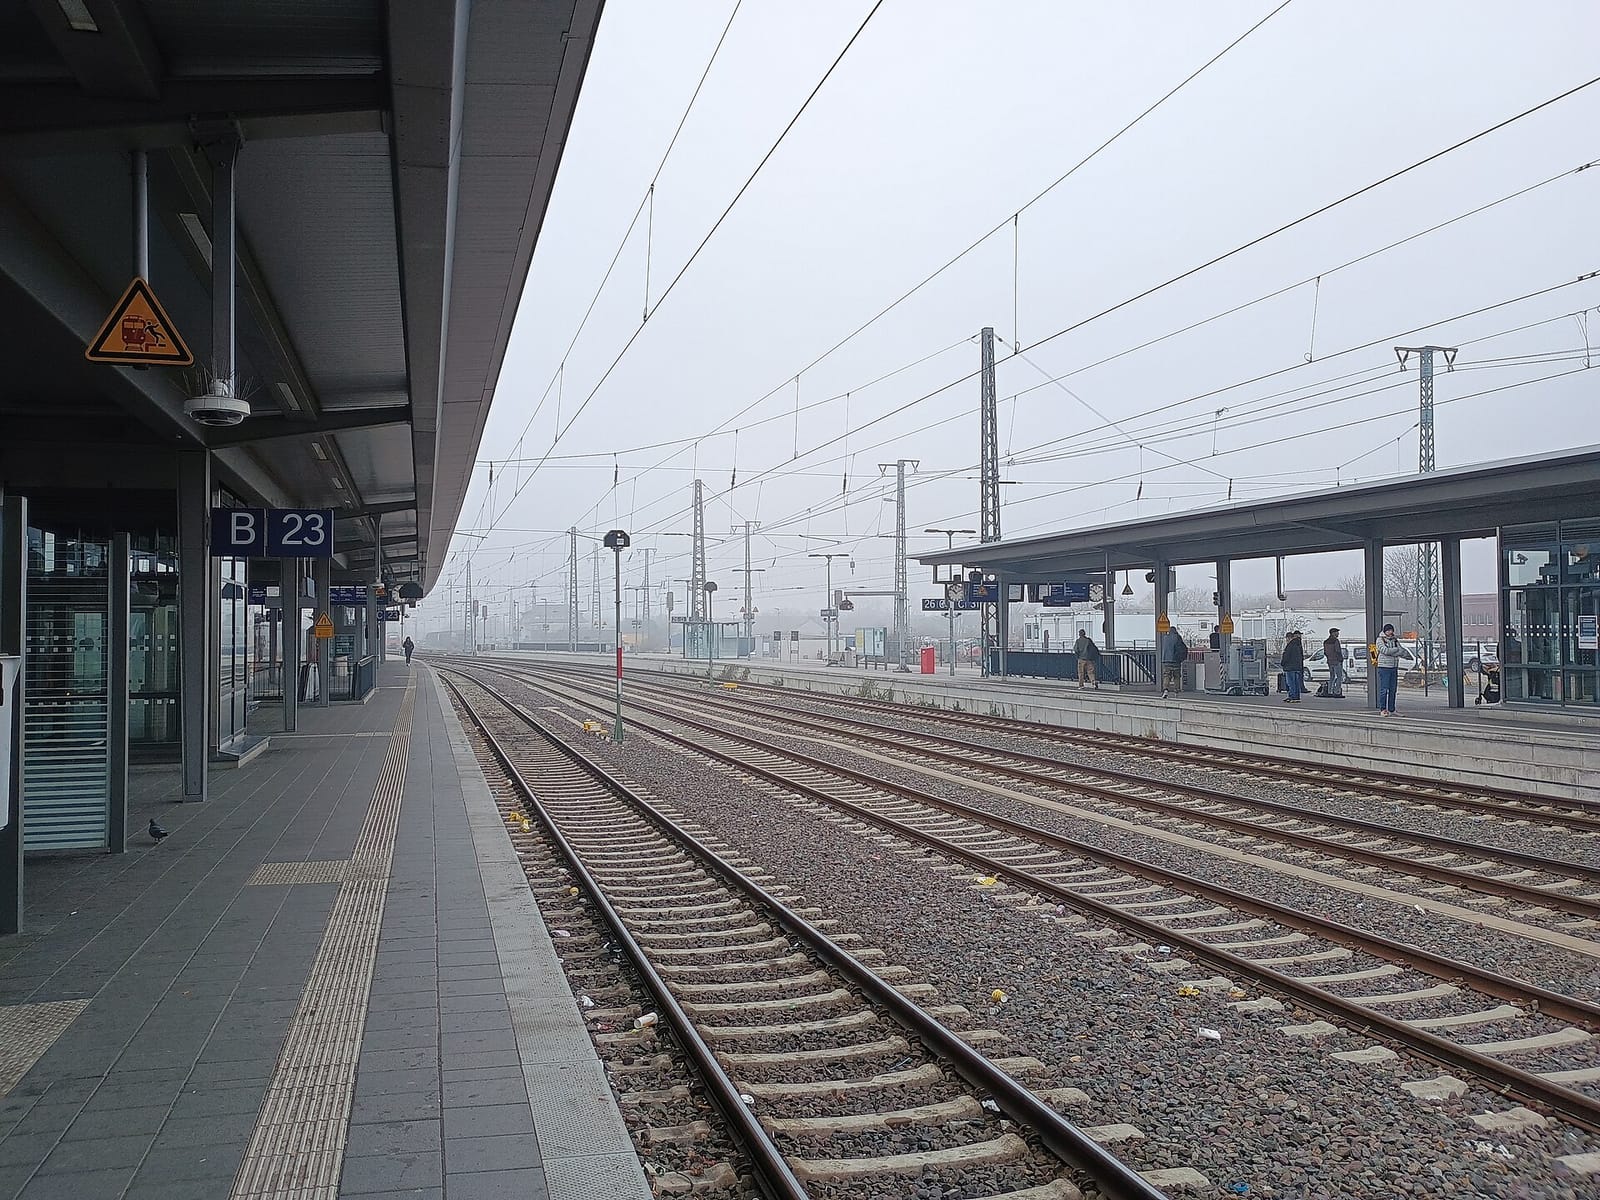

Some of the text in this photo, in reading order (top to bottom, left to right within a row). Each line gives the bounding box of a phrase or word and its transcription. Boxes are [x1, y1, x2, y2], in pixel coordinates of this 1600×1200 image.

[231, 512, 325, 546] B 23
[924, 600, 936, 608] 26
[388, 611, 398, 619] 23
